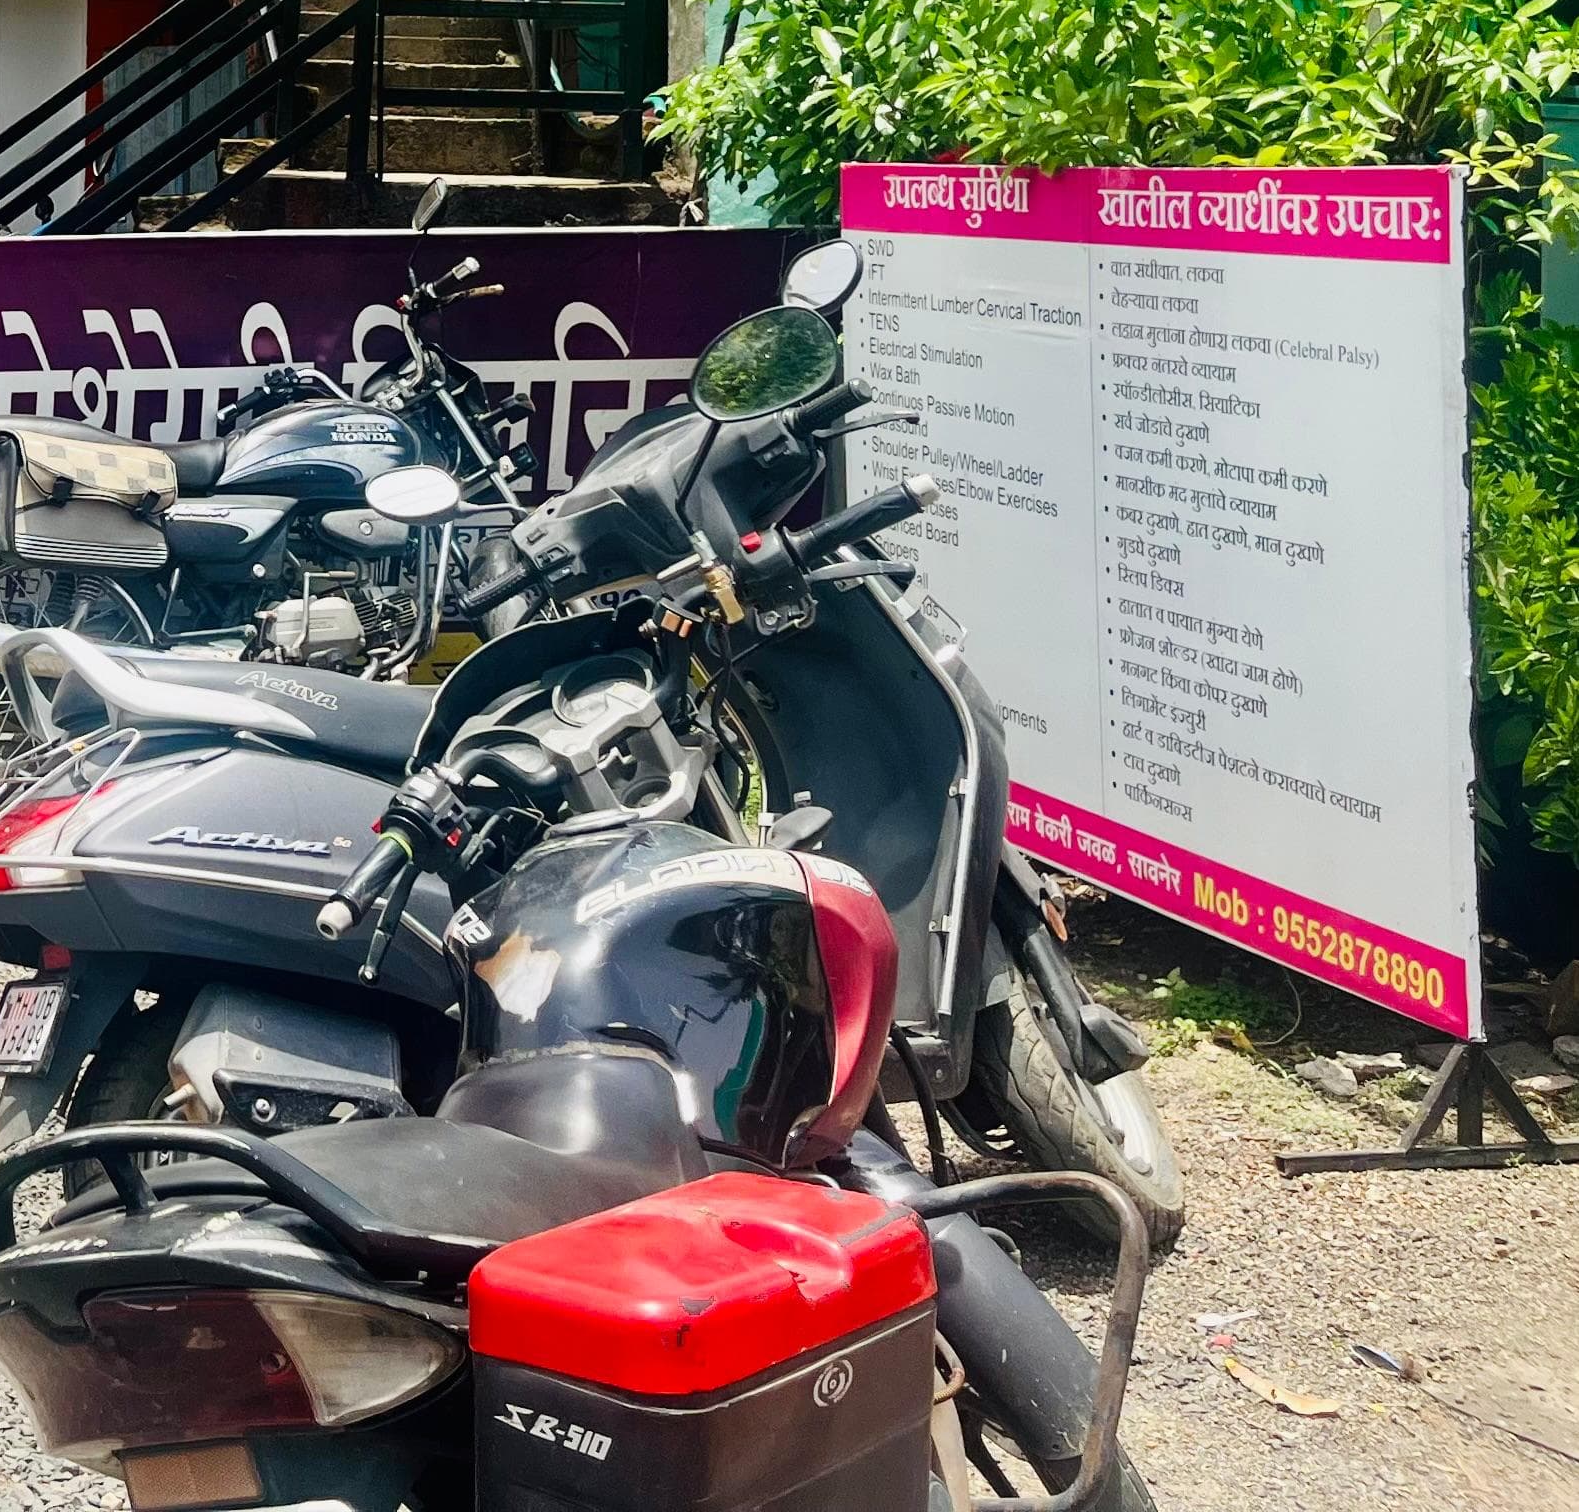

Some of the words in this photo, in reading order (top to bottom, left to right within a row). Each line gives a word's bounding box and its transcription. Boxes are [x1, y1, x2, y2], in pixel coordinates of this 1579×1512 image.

[883, 173, 955, 211] उपलब्ध
[959, 167, 1030, 229] सुविधा
[1097, 175, 1193, 230] खालील
[1197, 176, 1320, 236] व्याधींवर
[1325, 195, 1442, 242] उपचार:
[867, 238, 894, 257] SWD
[868, 263, 885, 280] IFT
[1111, 261, 1132, 277] वात
[1186, 266, 1225, 284] लकवा
[868, 288, 927, 310] Intermittent
[930, 294, 974, 315] Lumber
[976, 298, 1026, 321] Cervical
[1030, 303, 1082, 327] Traction
[1162, 296, 1199, 314] लकवा
[868, 312, 900, 332] TENS
[869, 336, 917, 359] Electrical
[920, 343, 983, 369] Stimulation
[1231, 334, 1272, 354] लकवा
[1337, 345, 1380, 370] Palsy)
[870, 362, 893, 381] Wax
[895, 364, 921, 386] Bath
[1191, 362, 1237, 383] व्यायाम
[927, 395, 971, 420] Passive
[974, 403, 1015, 427] Motion
[330, 432, 397, 443] HONDA
[334, 422, 389, 433] HERO
[1175, 421, 1210, 447] दुखणे
[871, 435, 919, 461] Shoulder
[922, 444, 1044, 487] Pulley/Wheel/Ladder
[1114, 443, 1143, 464] वजन
[1146, 448, 1172, 469] कमी
[1213, 457, 1255, 484] मोटापा
[1258, 467, 1288, 490] कमी
[1291, 473, 1328, 497] करणे
[872, 461, 899, 482] Wrist
[997, 486, 1058, 518] Exercises
[1229, 497, 1278, 521] व्यायाम
[926, 522, 959, 547] Board
[1186, 519, 1209, 540] हात
[1254, 534, 1282, 556] मान
[1285, 541, 1325, 567] दुखणे
[1147, 543, 1181, 567] दुखणे
[1118, 597, 1153, 621] हातात
[1155, 607, 1164, 624] व
[1167, 609, 1203, 634] पायात
[1241, 624, 1264, 651] येणे
[1120, 658, 1158, 684] मनगट
[1193, 678, 1228, 706] कोपर
[1230, 694, 1268, 718] दुखणे
[1241, 662, 1270, 685] जाम
[234, 669, 338, 712] Activa
[1145, 728, 1154, 746] व
[1329, 789, 1382, 823] व्यायाम
[1147, 760, 1181, 786] दुखणे
[147, 825, 332, 857] Activa
[1034, 802, 1072, 849] बेकरी
[1076, 828, 1123, 875] जवळ,
[1126, 849, 1182, 896] सावनेर
[1193, 871, 1250, 927] Mob
[1273, 904, 1445, 1009] 9552878890
